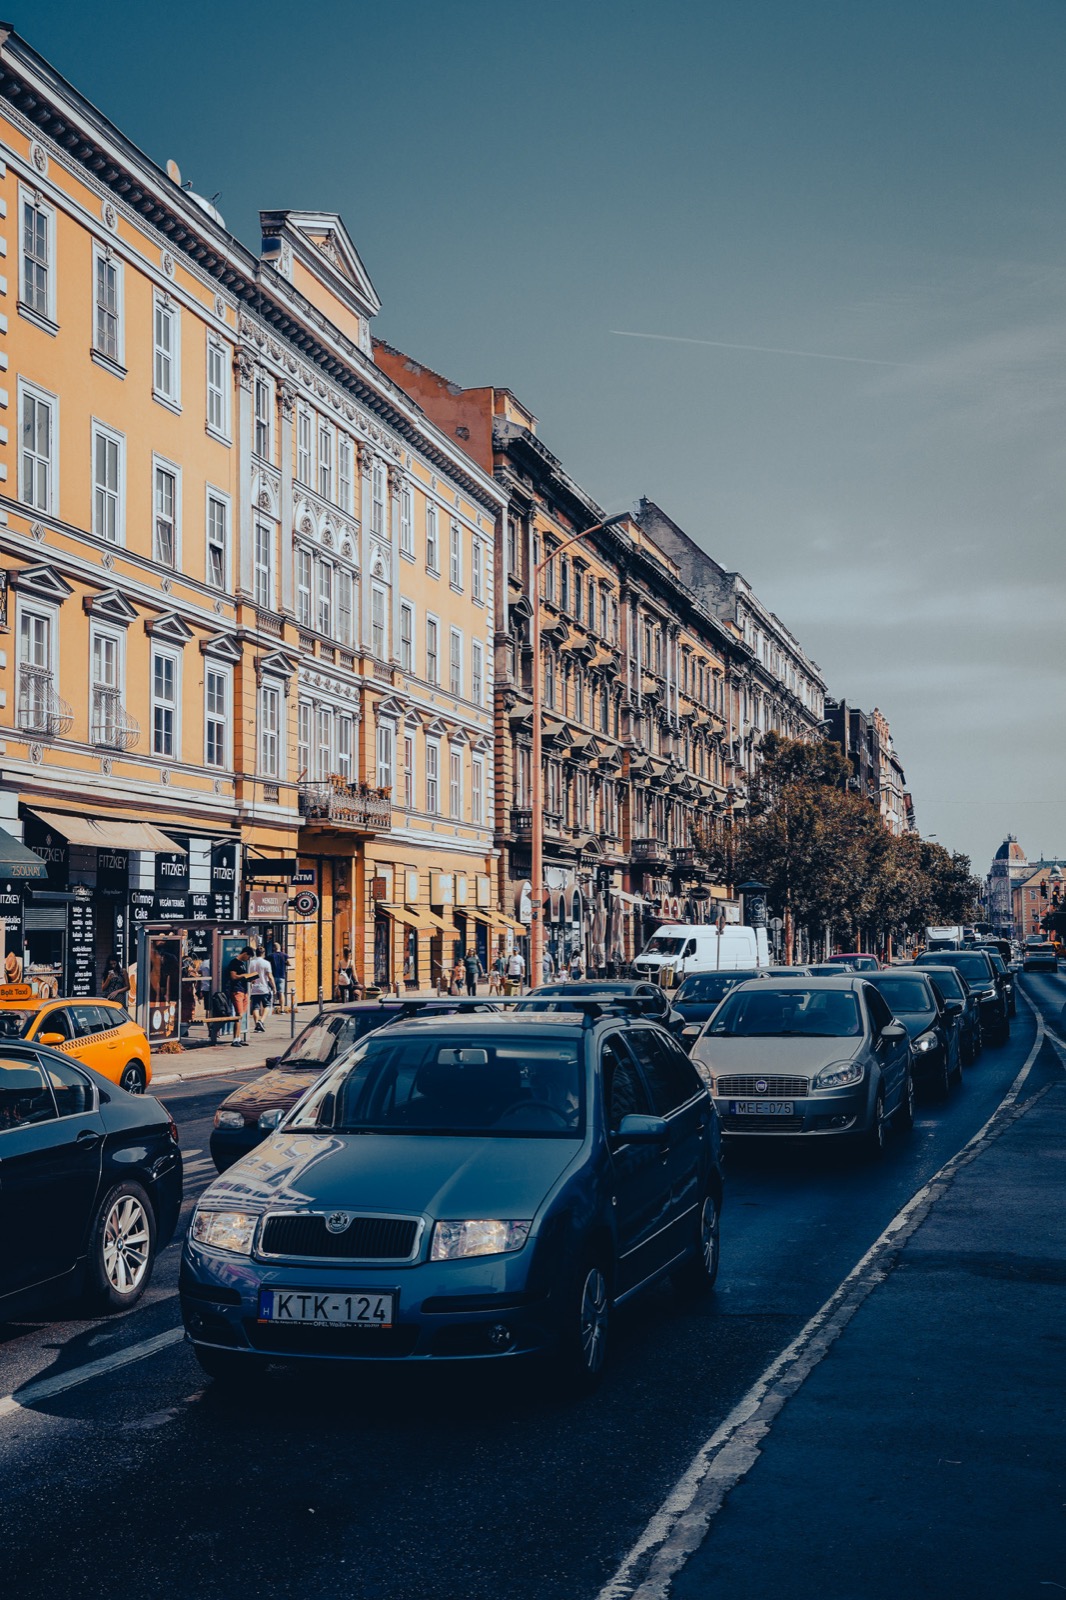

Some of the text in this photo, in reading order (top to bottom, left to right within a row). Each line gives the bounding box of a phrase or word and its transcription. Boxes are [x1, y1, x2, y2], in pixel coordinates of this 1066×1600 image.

[98, 854, 127, 869] FITZKEY
[12, 865, 41, 877] ZSOLNAY
[161, 862, 186, 877] FITZKEY
[213, 867, 235, 880] FITZKEY
[0, 894, 20, 904] ITZKEY
[131, 892, 154, 907] Chimney
[134, 907, 148, 919] Cake
[1, 989, 13, 997] Bolt
[738, 1102, 791, 1114] MEE-075
[263, 1307, 269, 1316] H
[278, 1294, 386, 1322] KTK-124
